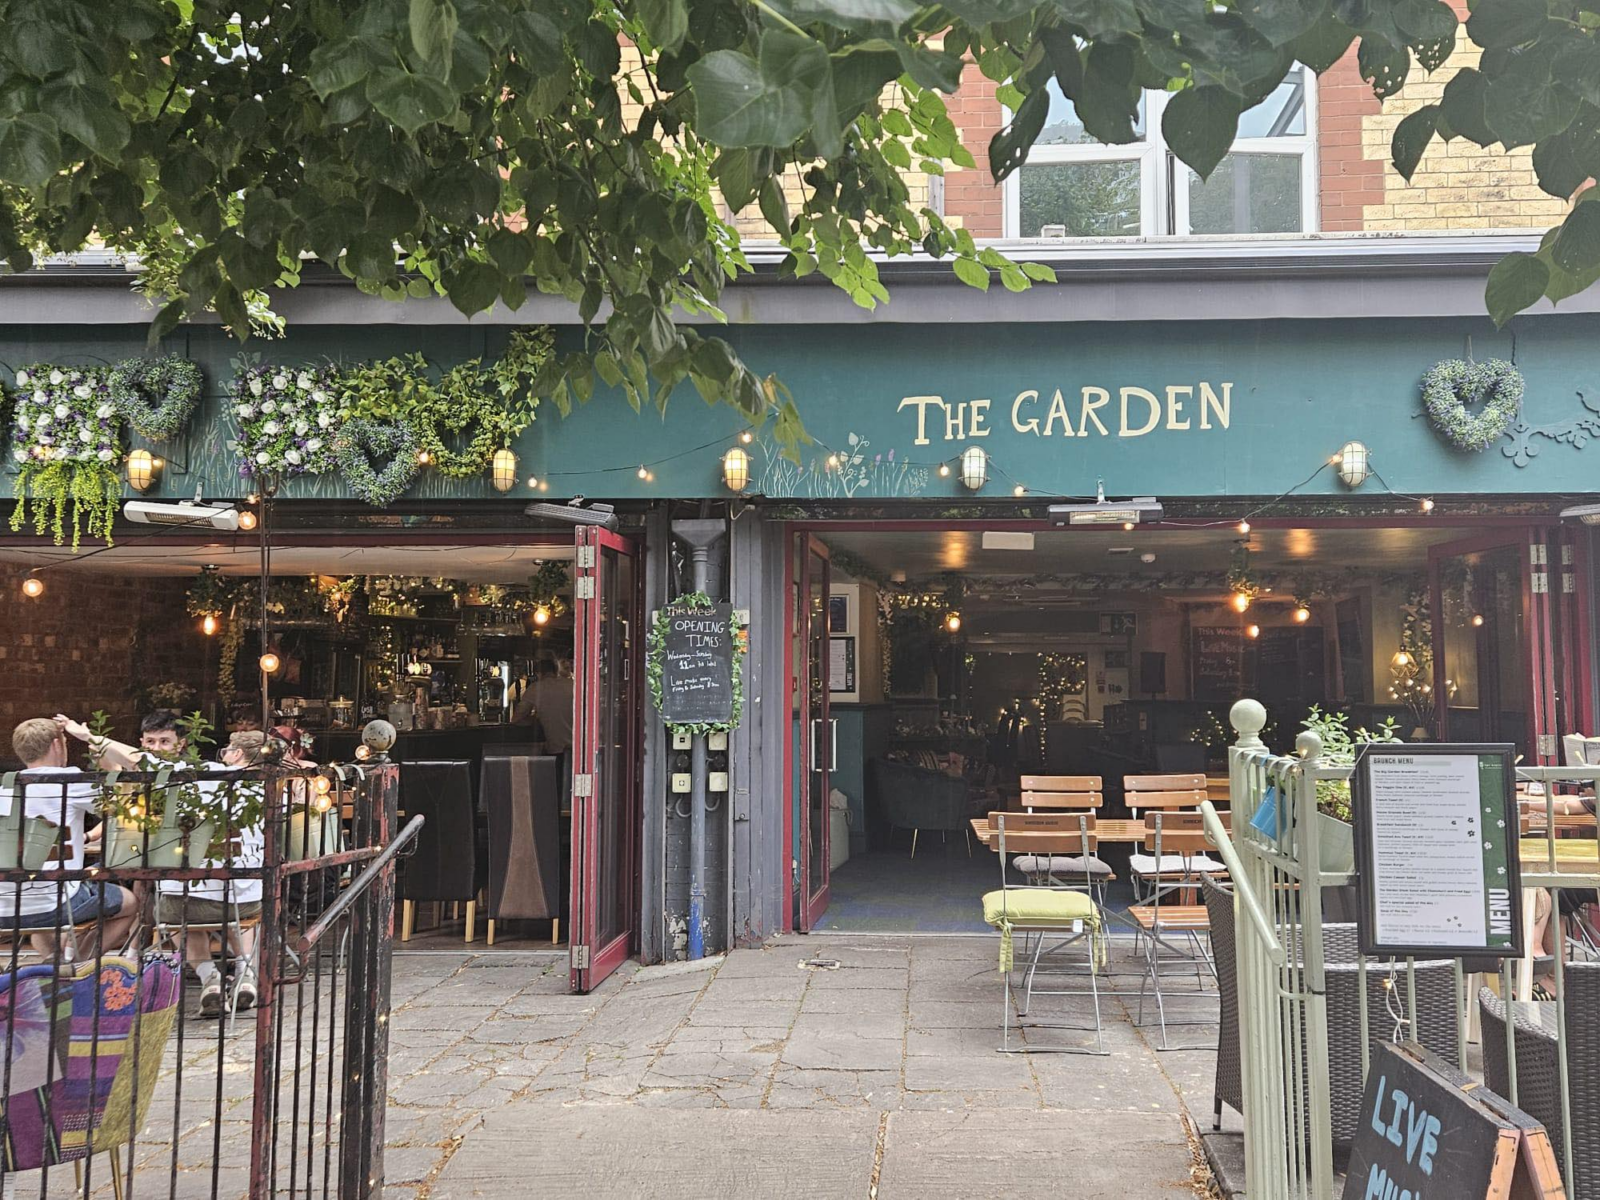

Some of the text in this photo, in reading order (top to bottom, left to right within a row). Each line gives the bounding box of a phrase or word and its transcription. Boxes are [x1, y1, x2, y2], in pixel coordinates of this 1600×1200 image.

[896, 382, 1234, 446] THE GARDEN
[666, 606, 717, 616] This Week
[674, 620, 725, 634] OPENING
[686, 634, 722, 648] TIMES:
[1488, 888, 1512, 934] MENU
[1372, 1075, 1441, 1176] LIVE
